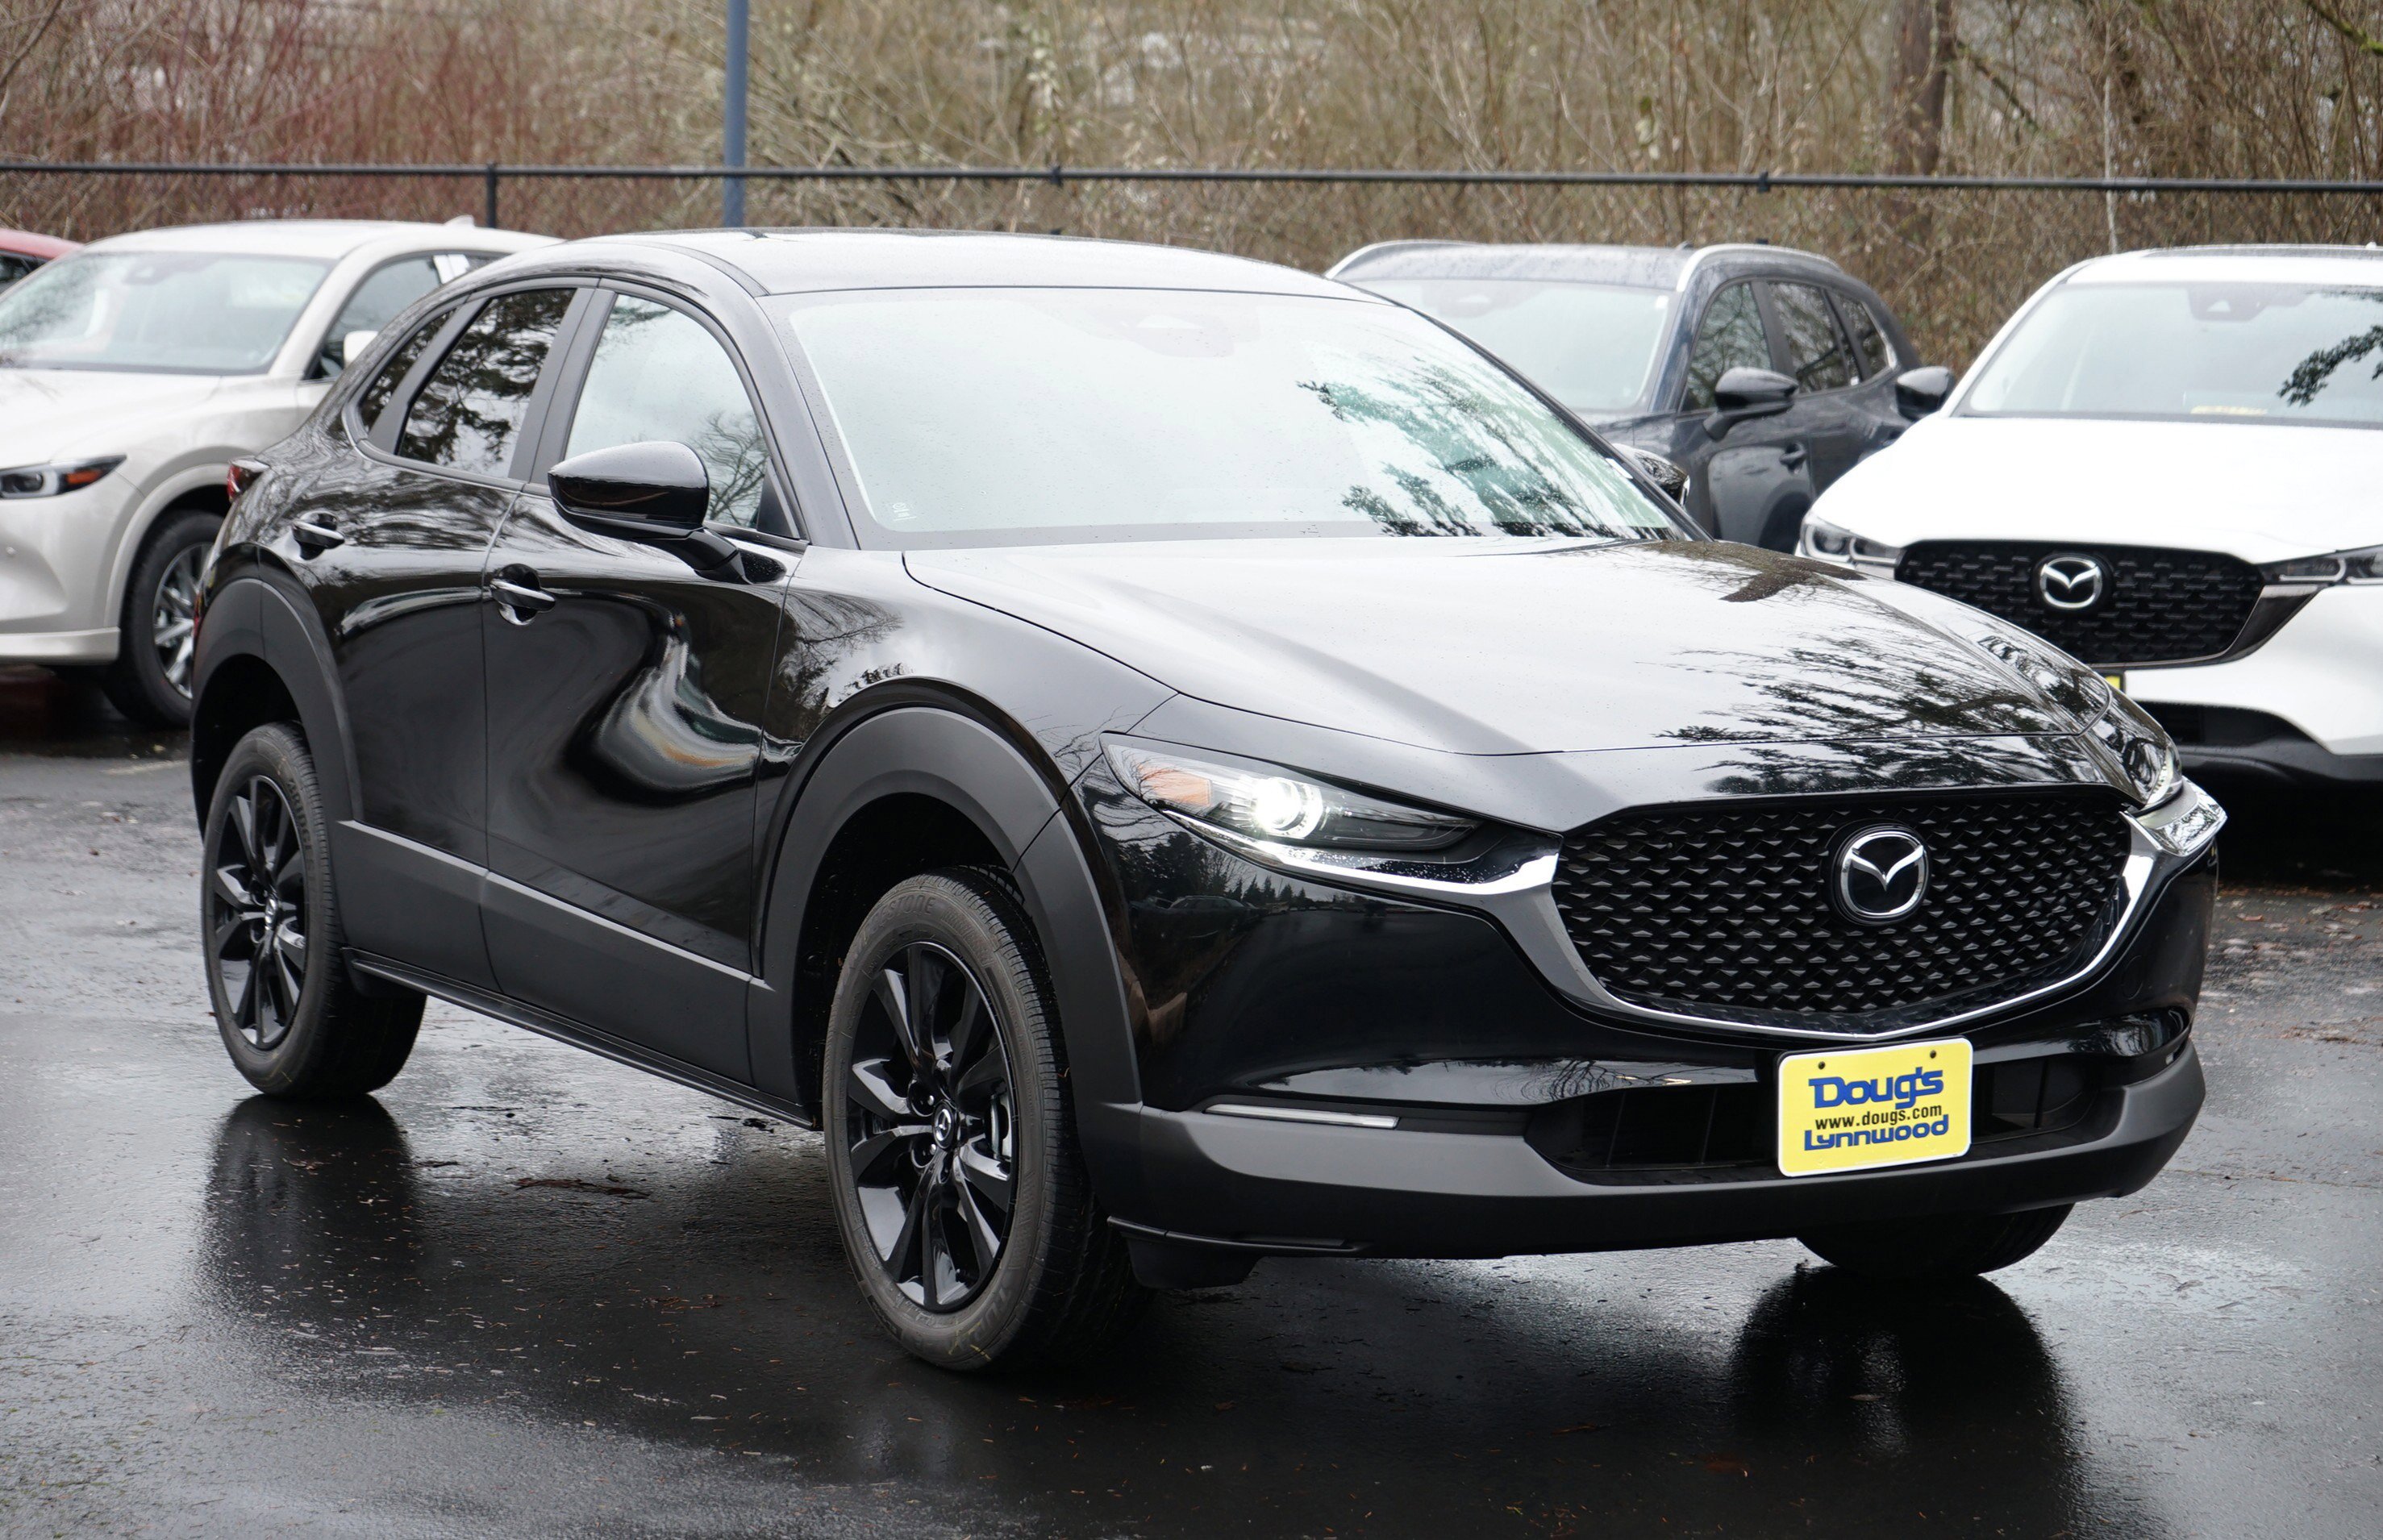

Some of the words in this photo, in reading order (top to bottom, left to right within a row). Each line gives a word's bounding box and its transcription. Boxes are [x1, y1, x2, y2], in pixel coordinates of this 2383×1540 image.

[1808, 1067, 1944, 1109] Doug's
[1804, 1113, 1949, 1151] Lynnwood
[1815, 1105, 1943, 1130] www.dougs.com
